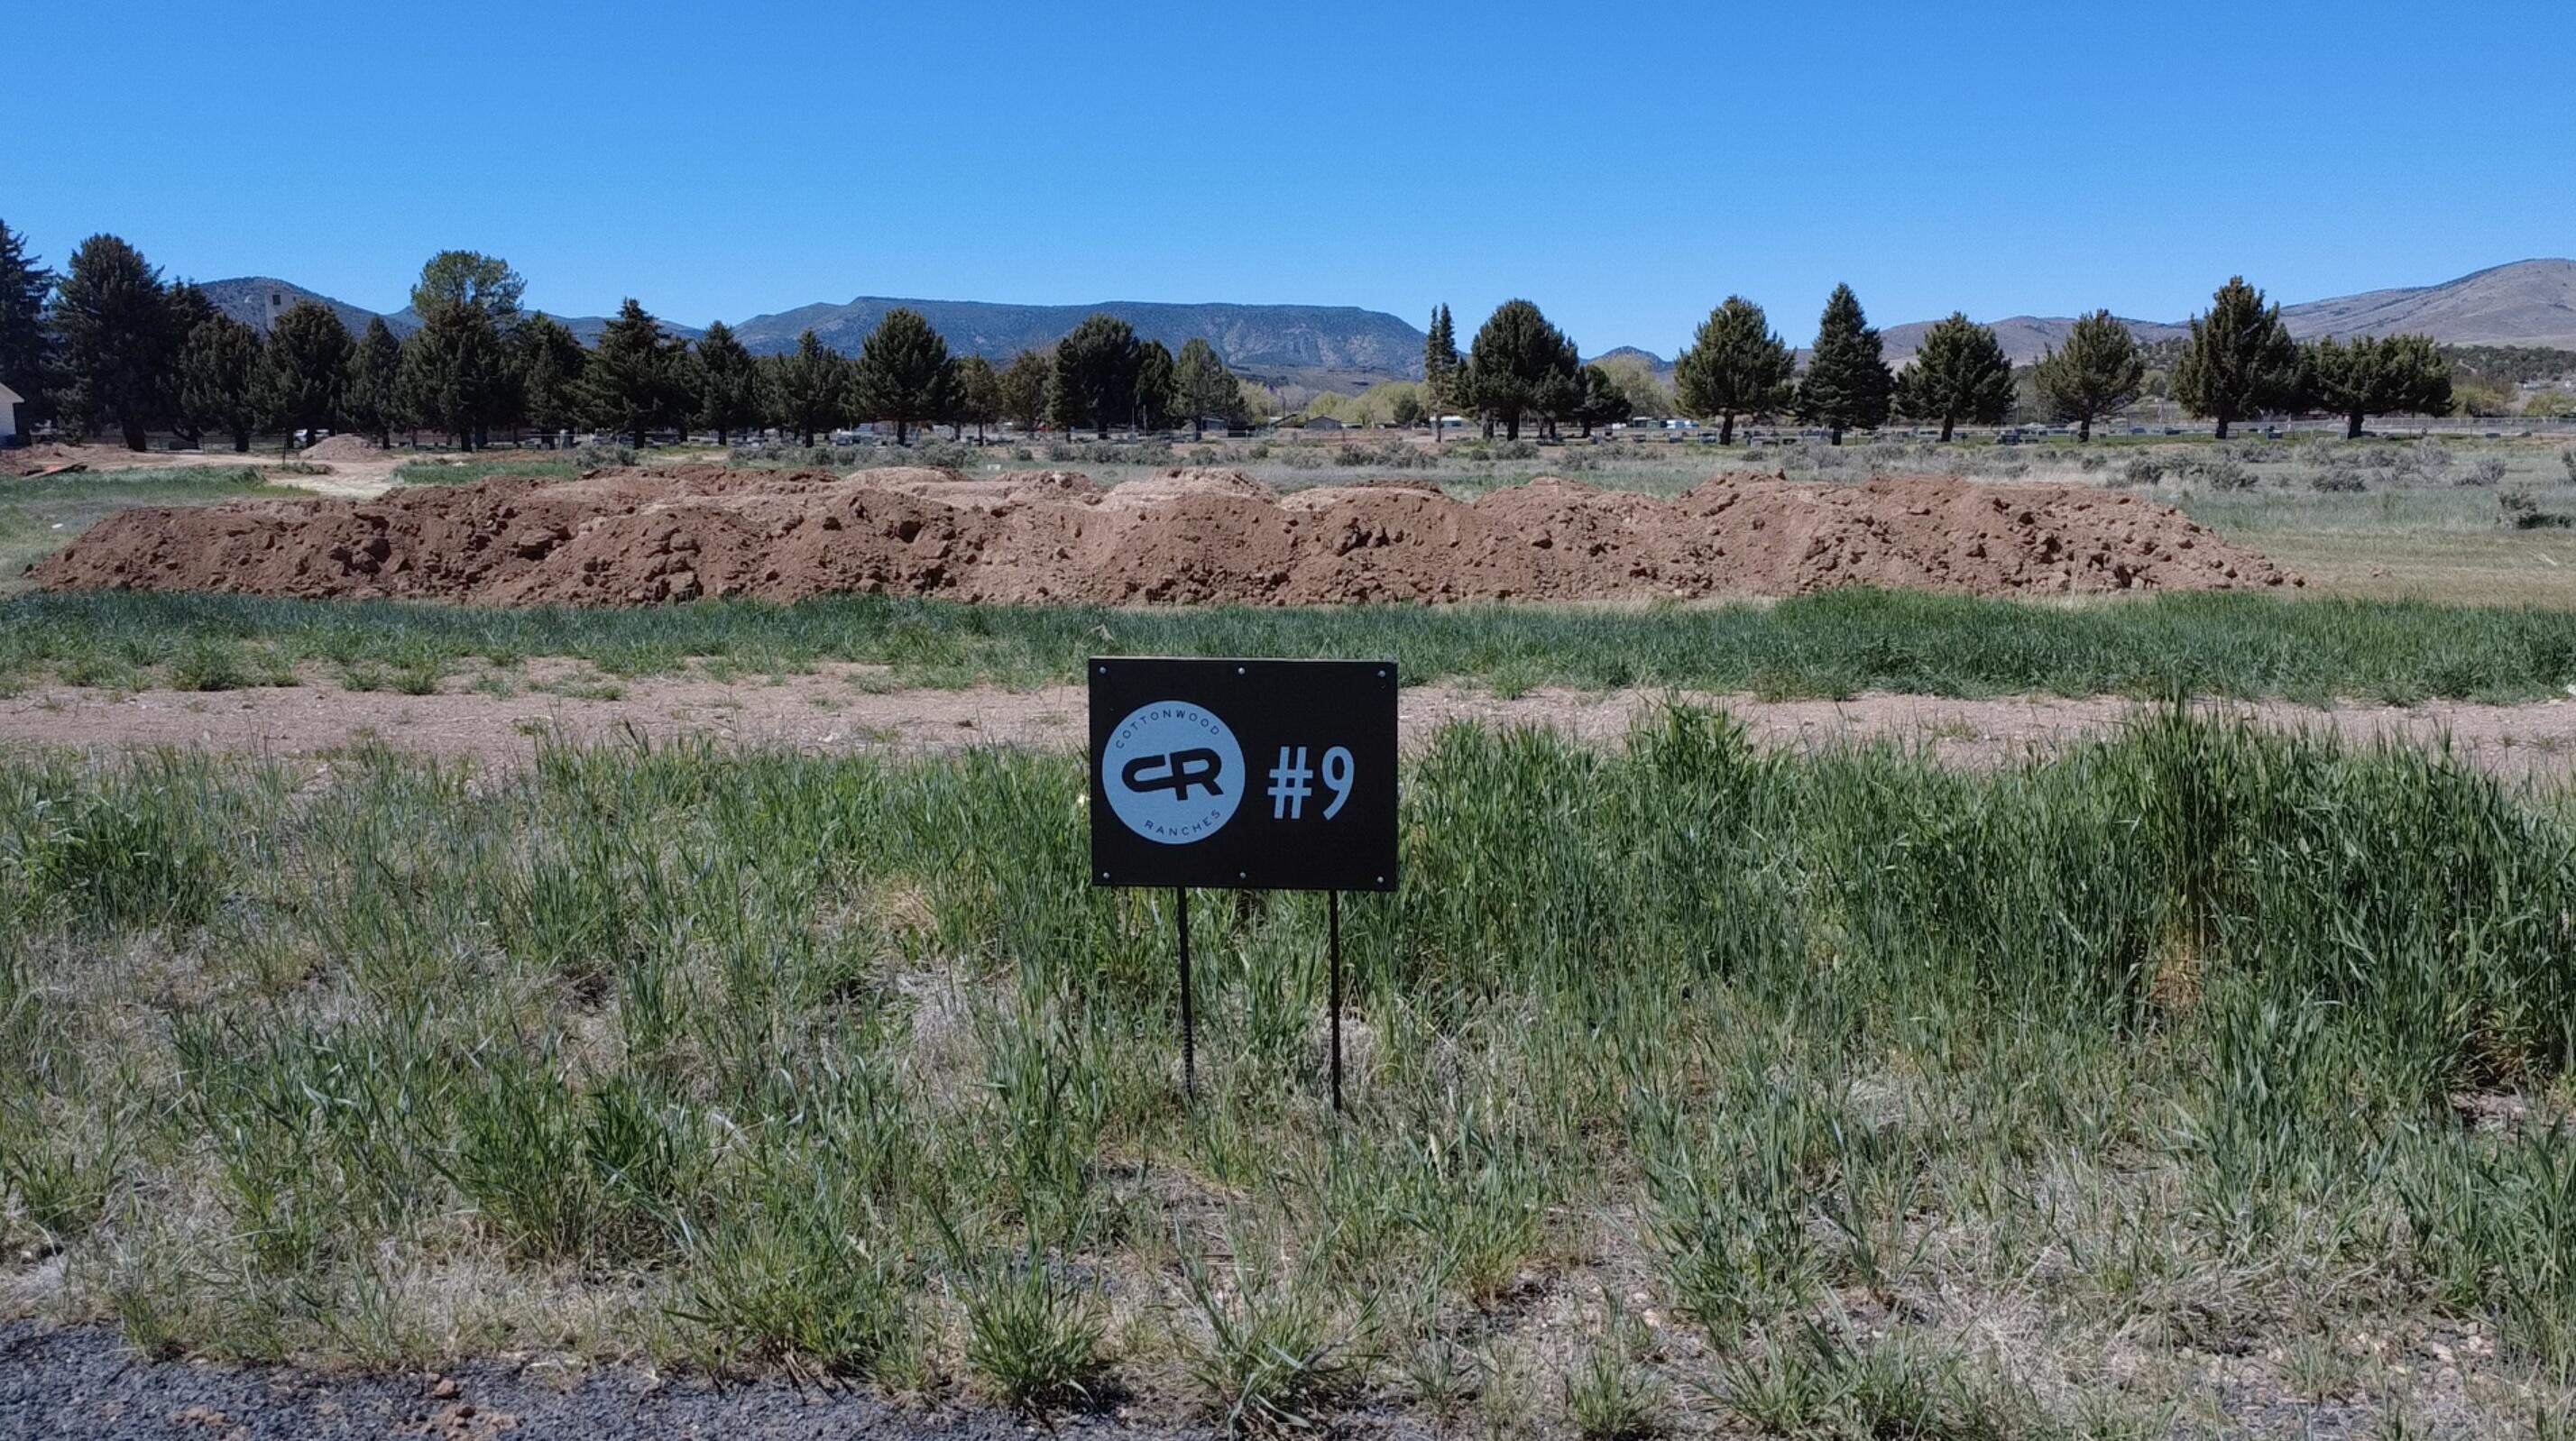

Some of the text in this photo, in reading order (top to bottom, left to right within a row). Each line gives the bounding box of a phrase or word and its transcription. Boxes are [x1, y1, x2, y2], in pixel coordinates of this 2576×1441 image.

[1116, 709, 1220, 749] COTTONWOOD
[1267, 746, 1355, 821] #9
[1144, 808, 1221, 837] RANCHES
